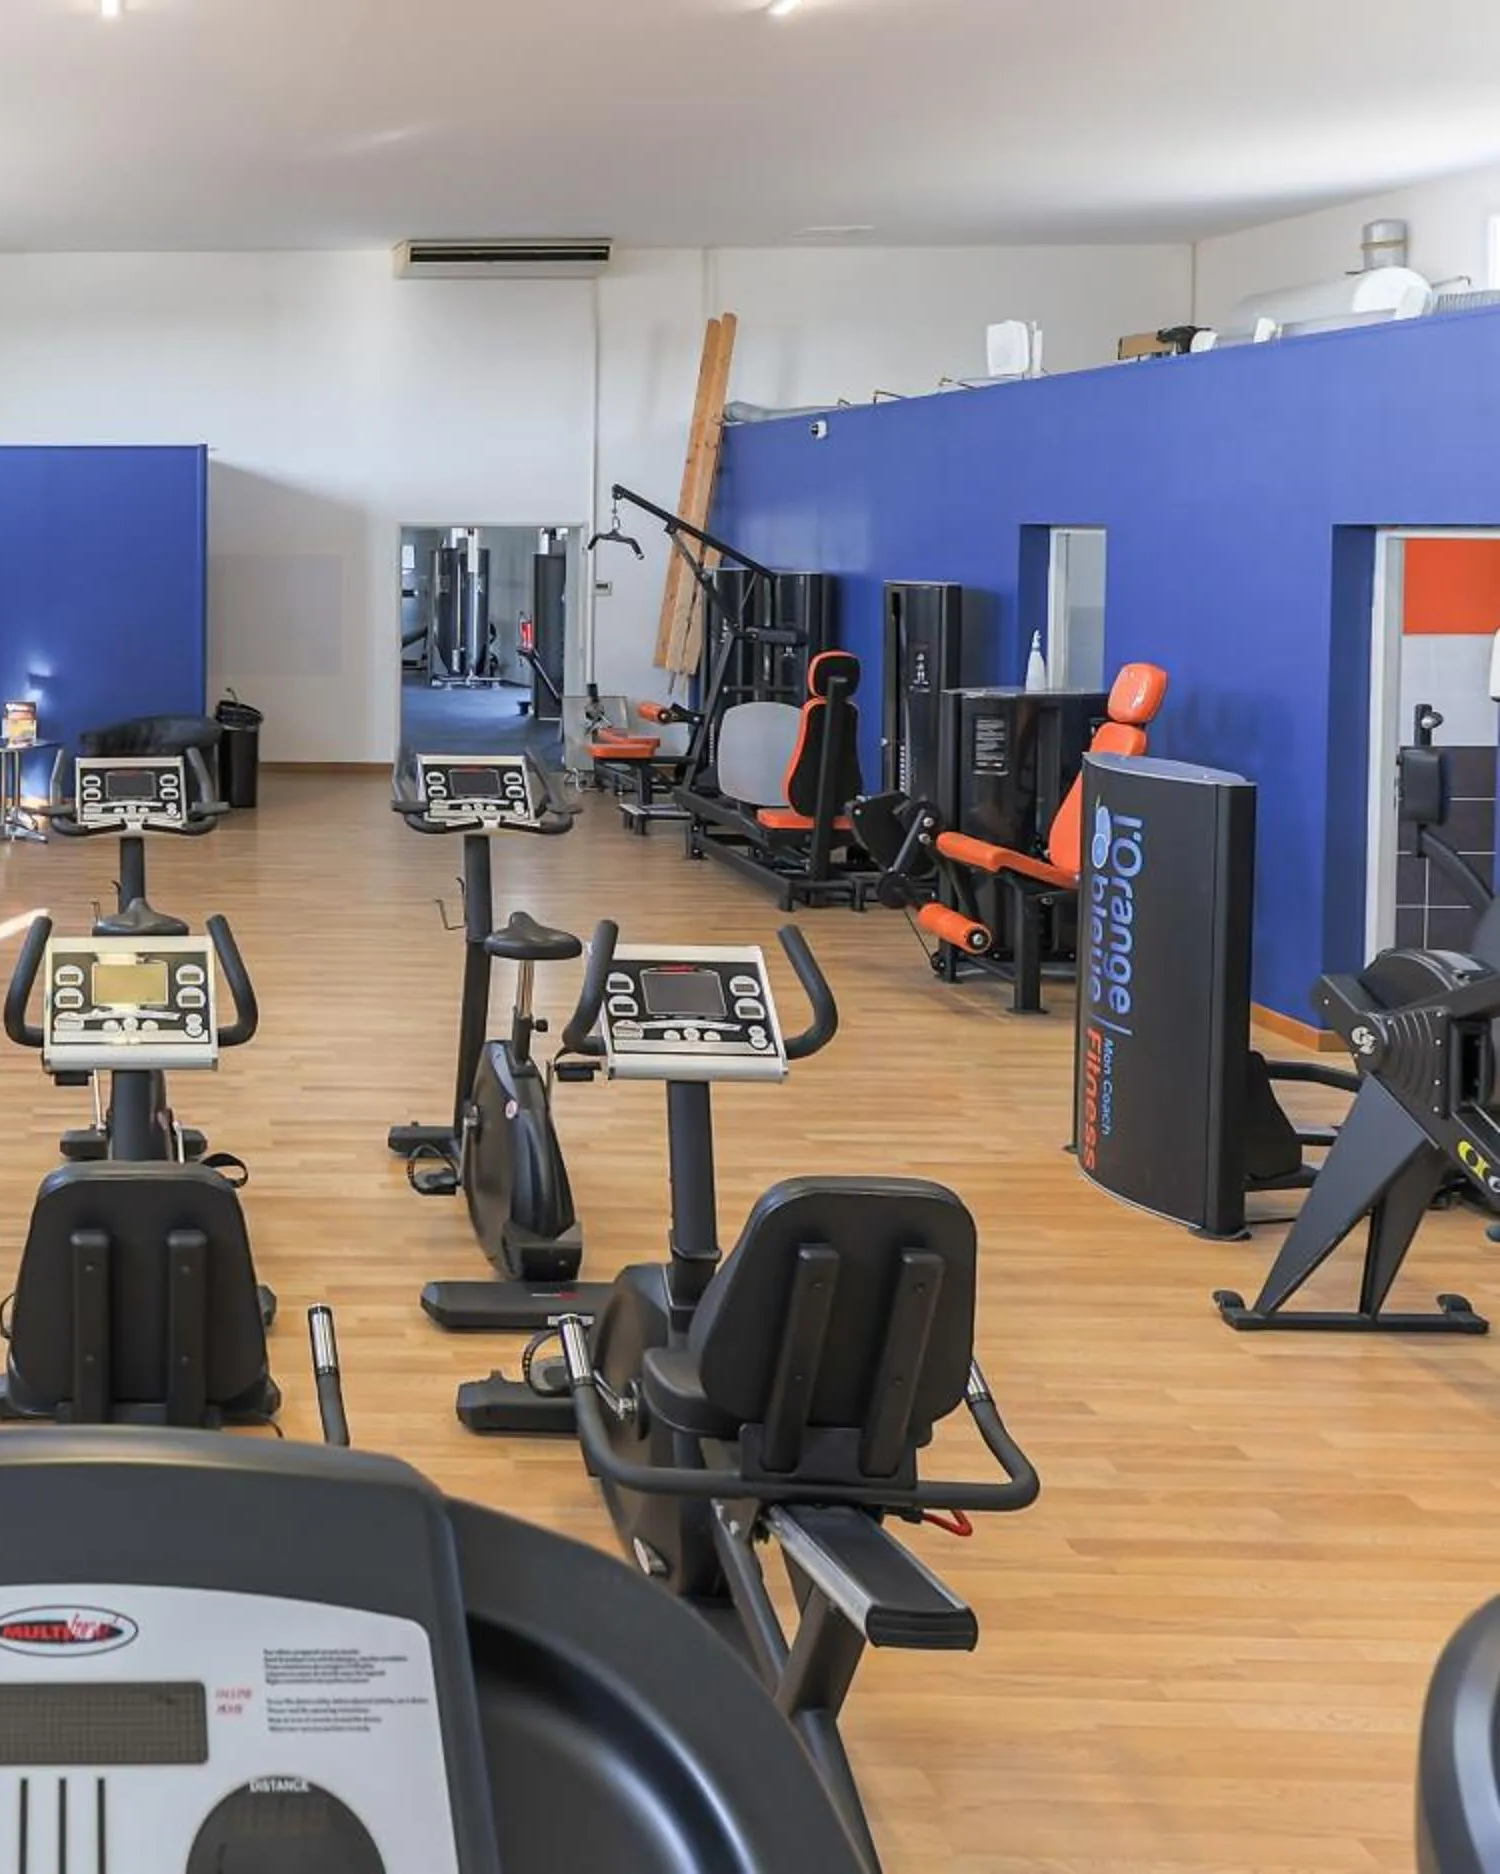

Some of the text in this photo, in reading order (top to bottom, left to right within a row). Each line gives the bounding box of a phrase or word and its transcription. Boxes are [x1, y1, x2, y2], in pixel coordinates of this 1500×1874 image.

[1091, 872, 1109, 1003] bleue
[1109, 813, 1144, 1016] l'Orange
[1083, 1026, 1102, 1171] Fitness
[1100, 1037, 1117, 1137] Mon Coach
[250, 1779, 309, 1793] DISTANCE
